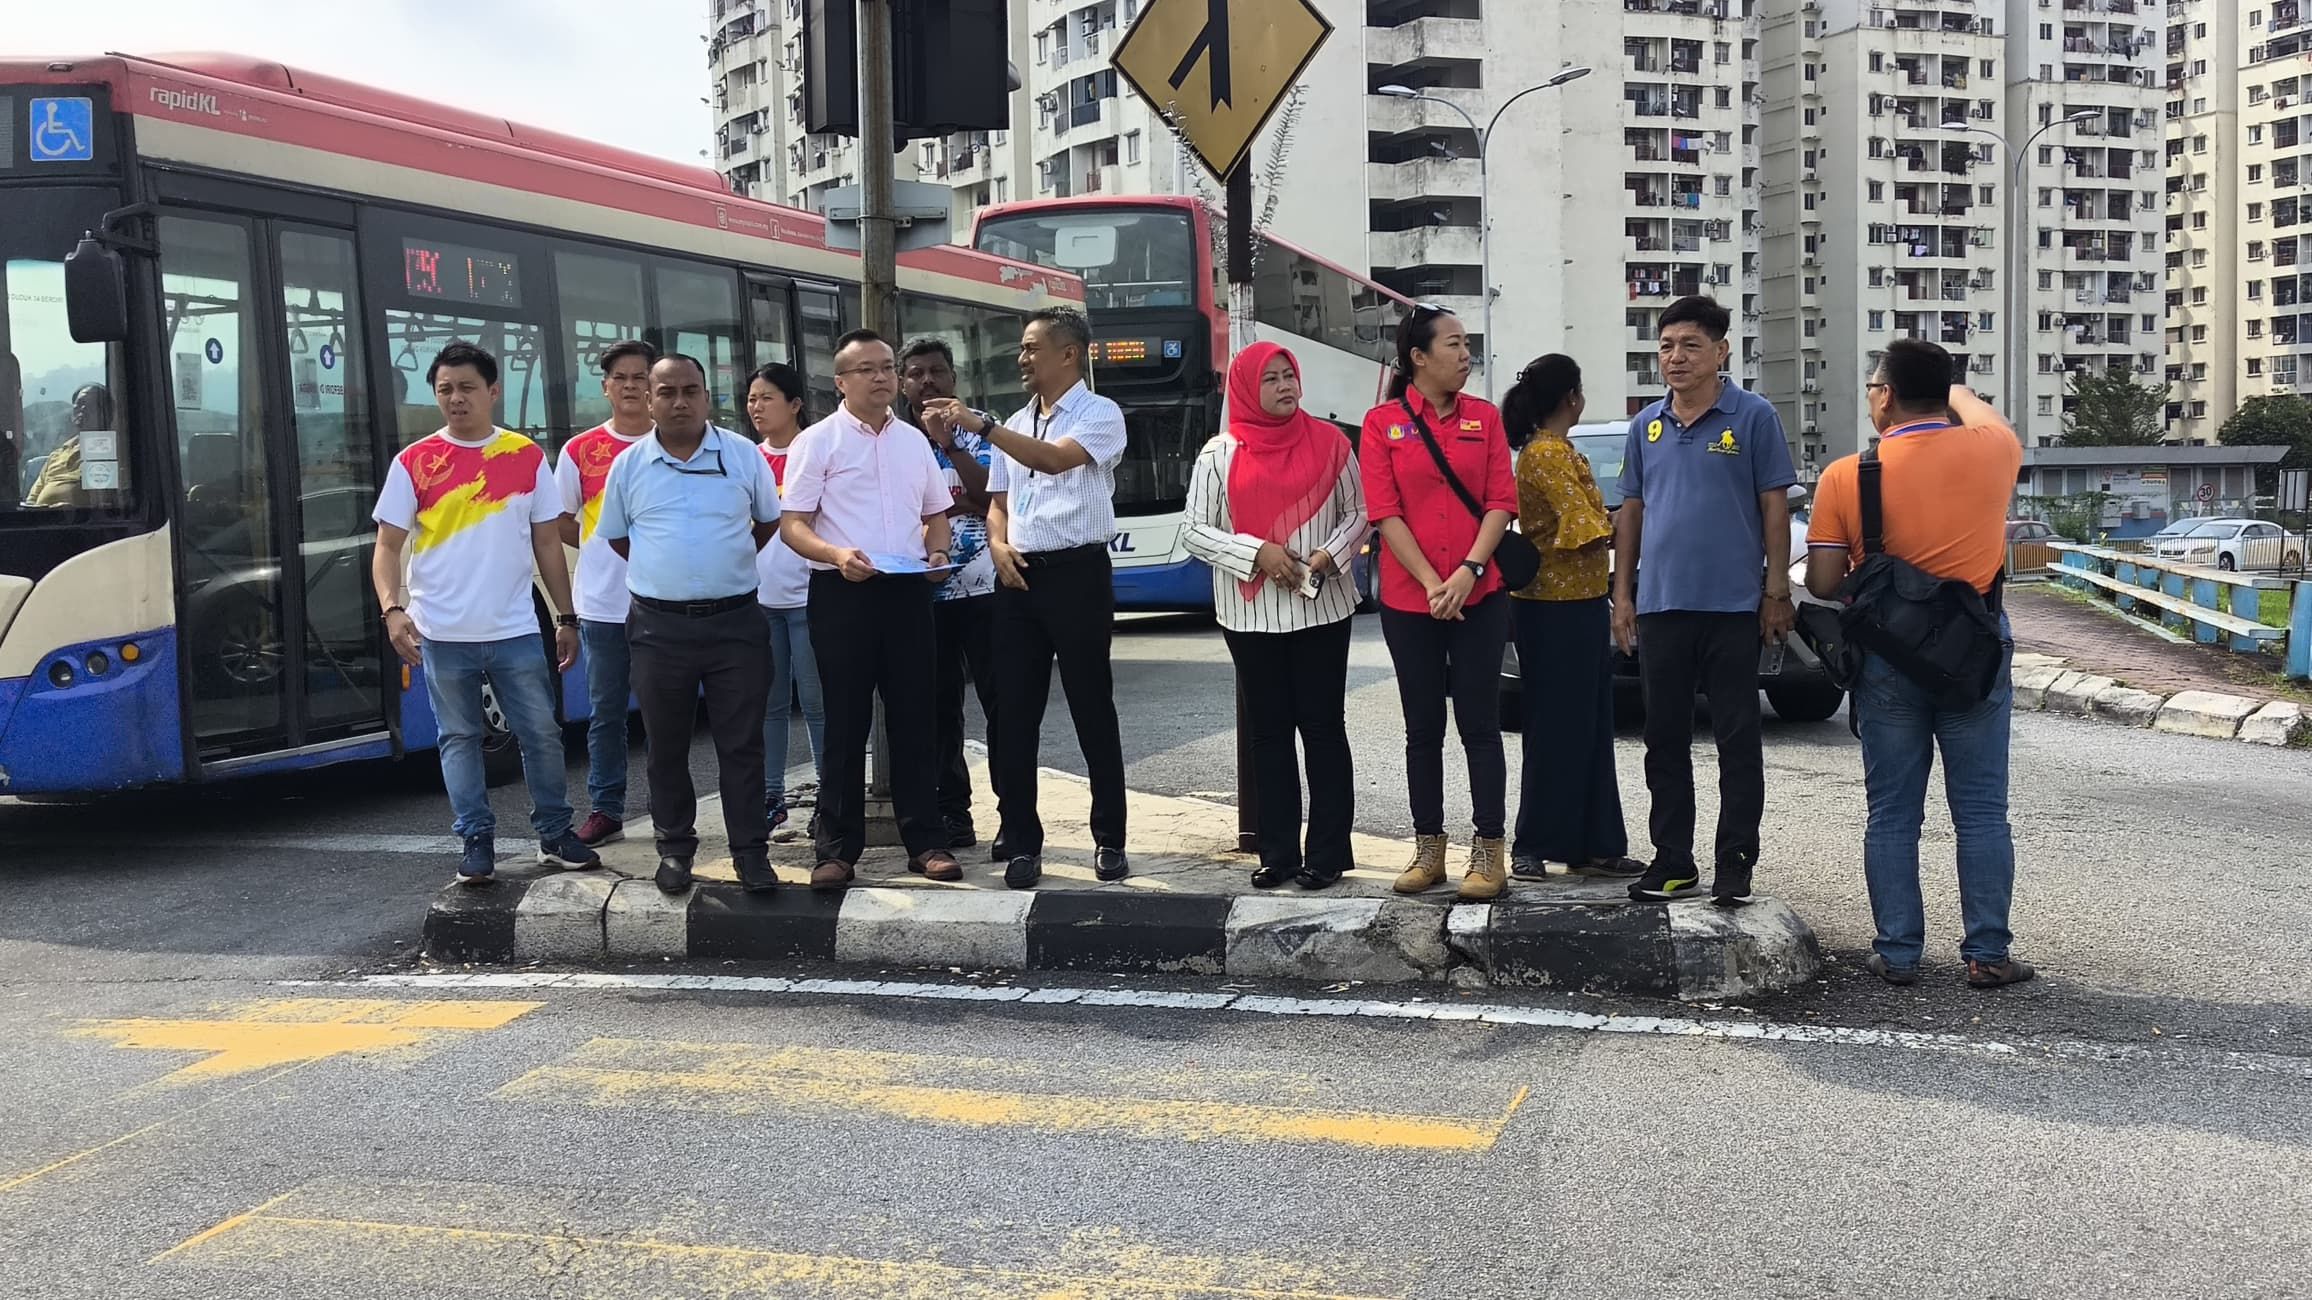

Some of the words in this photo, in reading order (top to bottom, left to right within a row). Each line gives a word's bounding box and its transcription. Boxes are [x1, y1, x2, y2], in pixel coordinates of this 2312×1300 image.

[149, 86, 221, 116] rapidKL
[1647, 419, 1663, 443] 9
[2200, 486, 2212, 498] 30
